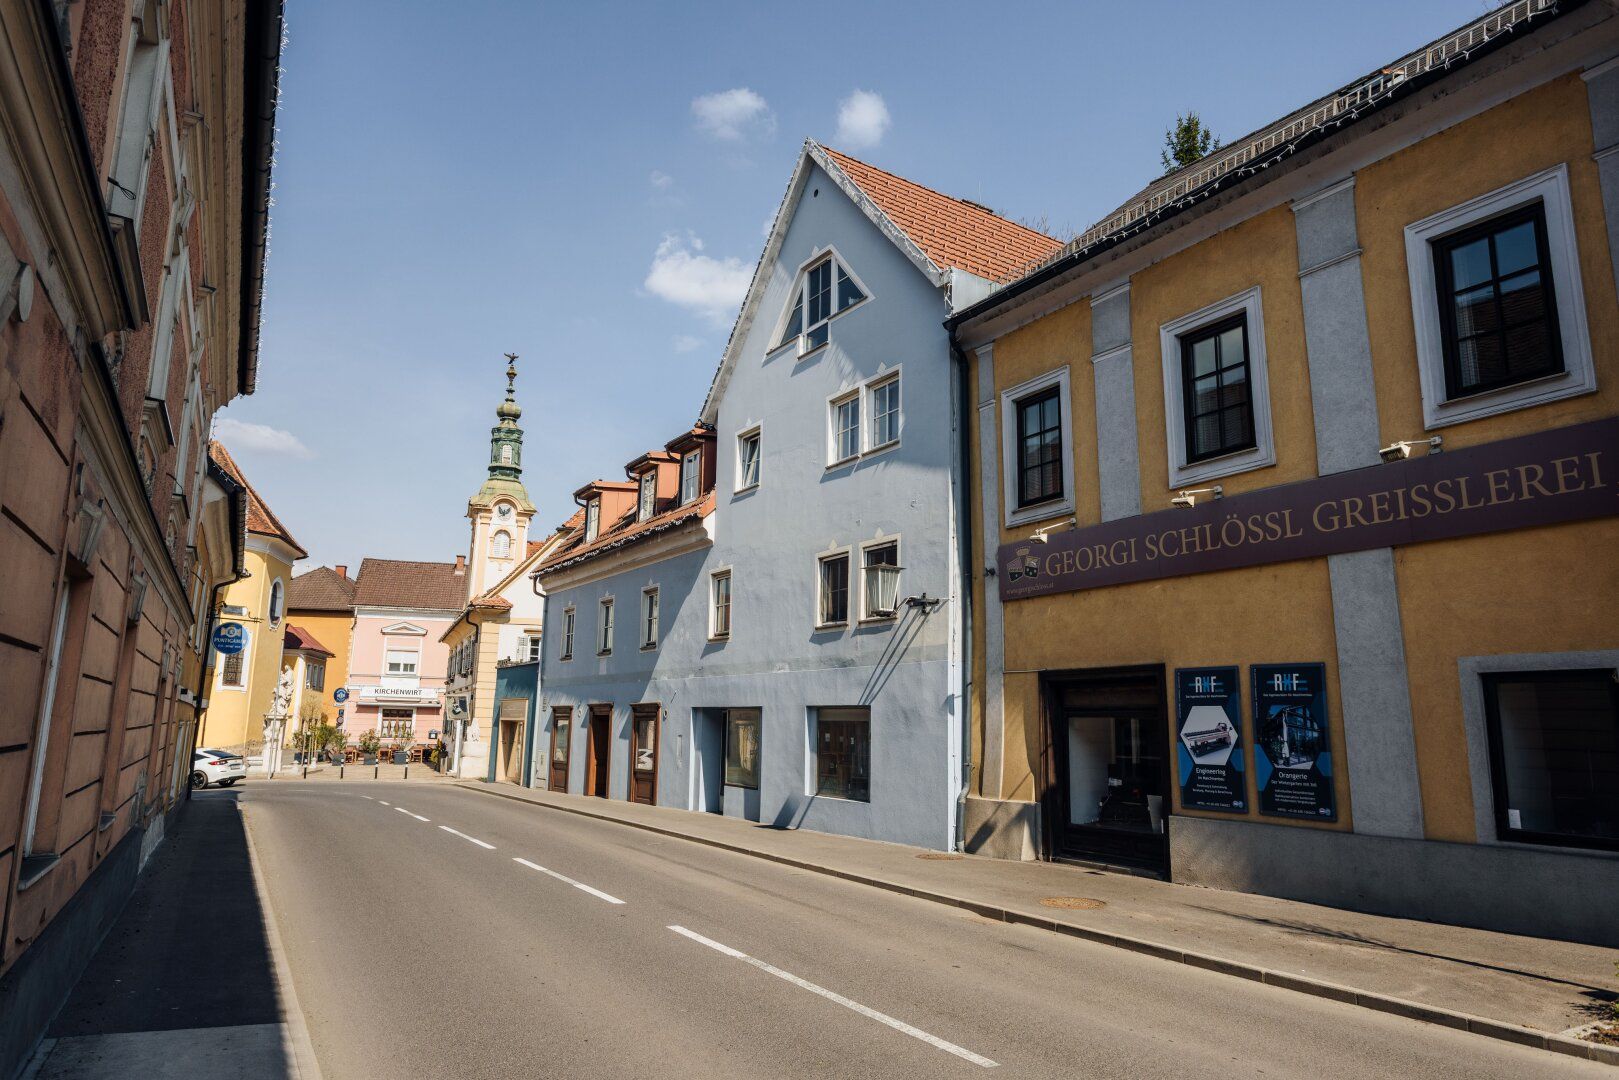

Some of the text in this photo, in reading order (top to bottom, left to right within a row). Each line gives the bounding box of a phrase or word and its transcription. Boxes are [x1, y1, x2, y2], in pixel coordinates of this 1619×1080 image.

[1045, 452, 1607, 577] GEORGI SCHLÖSSL GREISSLEREI
[1195, 768, 1226, 777] Engineering
[1278, 771, 1308, 780] Orangerie
